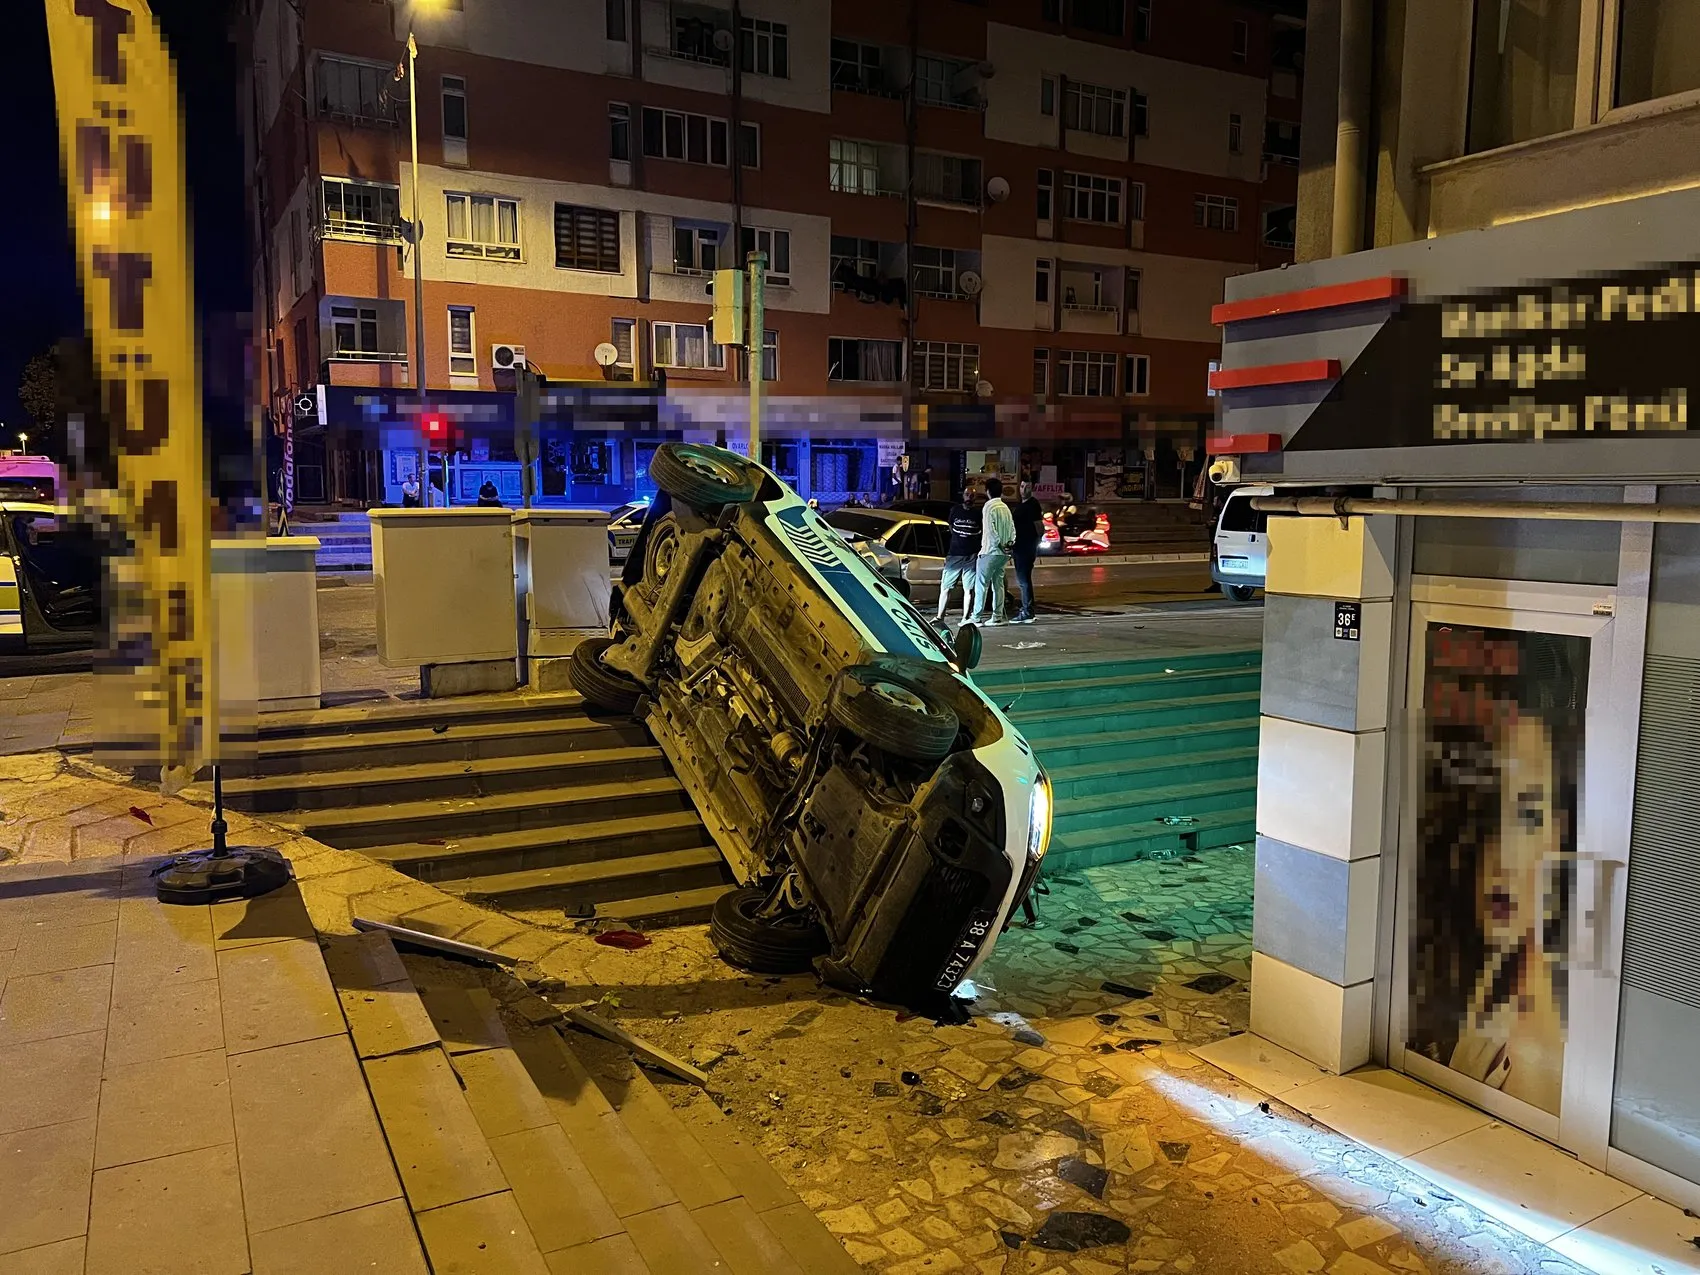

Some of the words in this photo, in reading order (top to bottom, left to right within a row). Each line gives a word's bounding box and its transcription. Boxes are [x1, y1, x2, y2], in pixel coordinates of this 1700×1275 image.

[969, 920, 989, 936] 38
[960, 940, 976, 949] A
[937, 952, 970, 989] 74323
